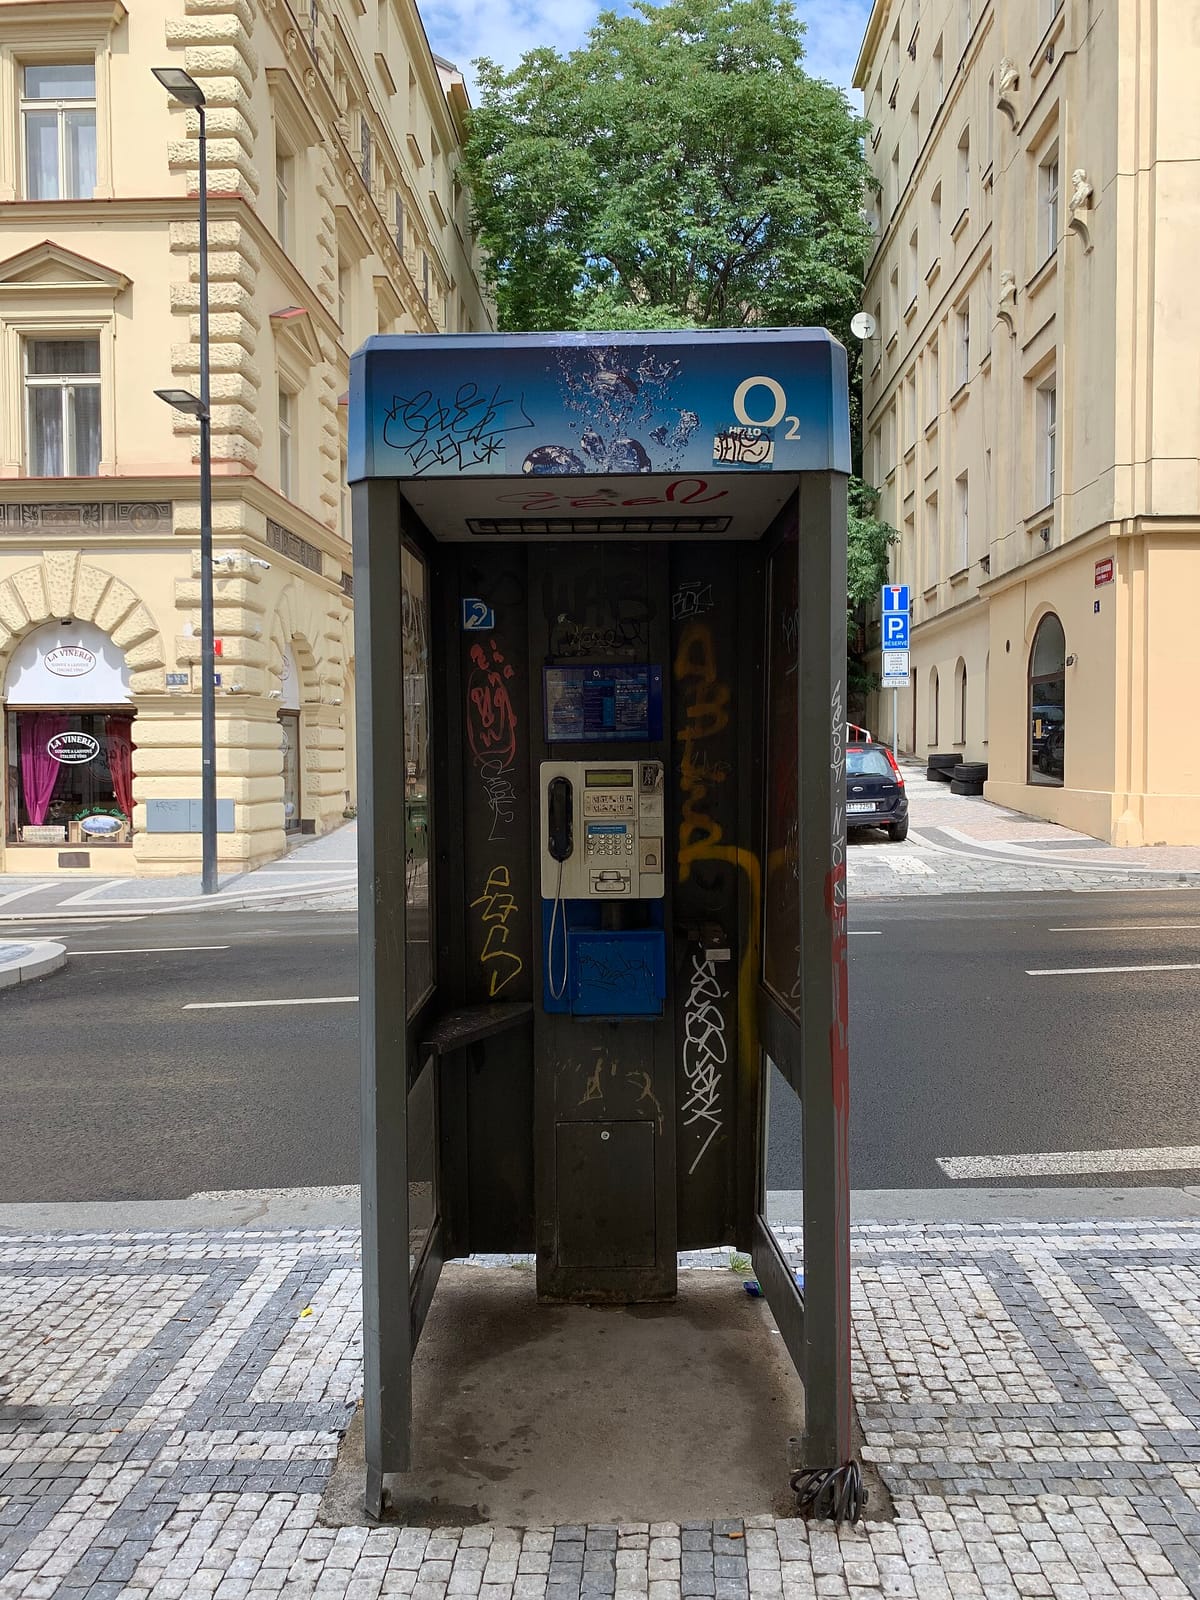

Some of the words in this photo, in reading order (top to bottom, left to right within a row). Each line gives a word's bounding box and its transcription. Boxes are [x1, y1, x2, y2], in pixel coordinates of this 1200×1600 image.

[733, 375, 801, 440] O2
[888, 618, 904, 639] P
[47, 652, 58, 662] LA
[60, 649, 92, 662] VINERIA
[50, 739, 62, 749] LA
[62, 735, 96, 749] VINERIA
